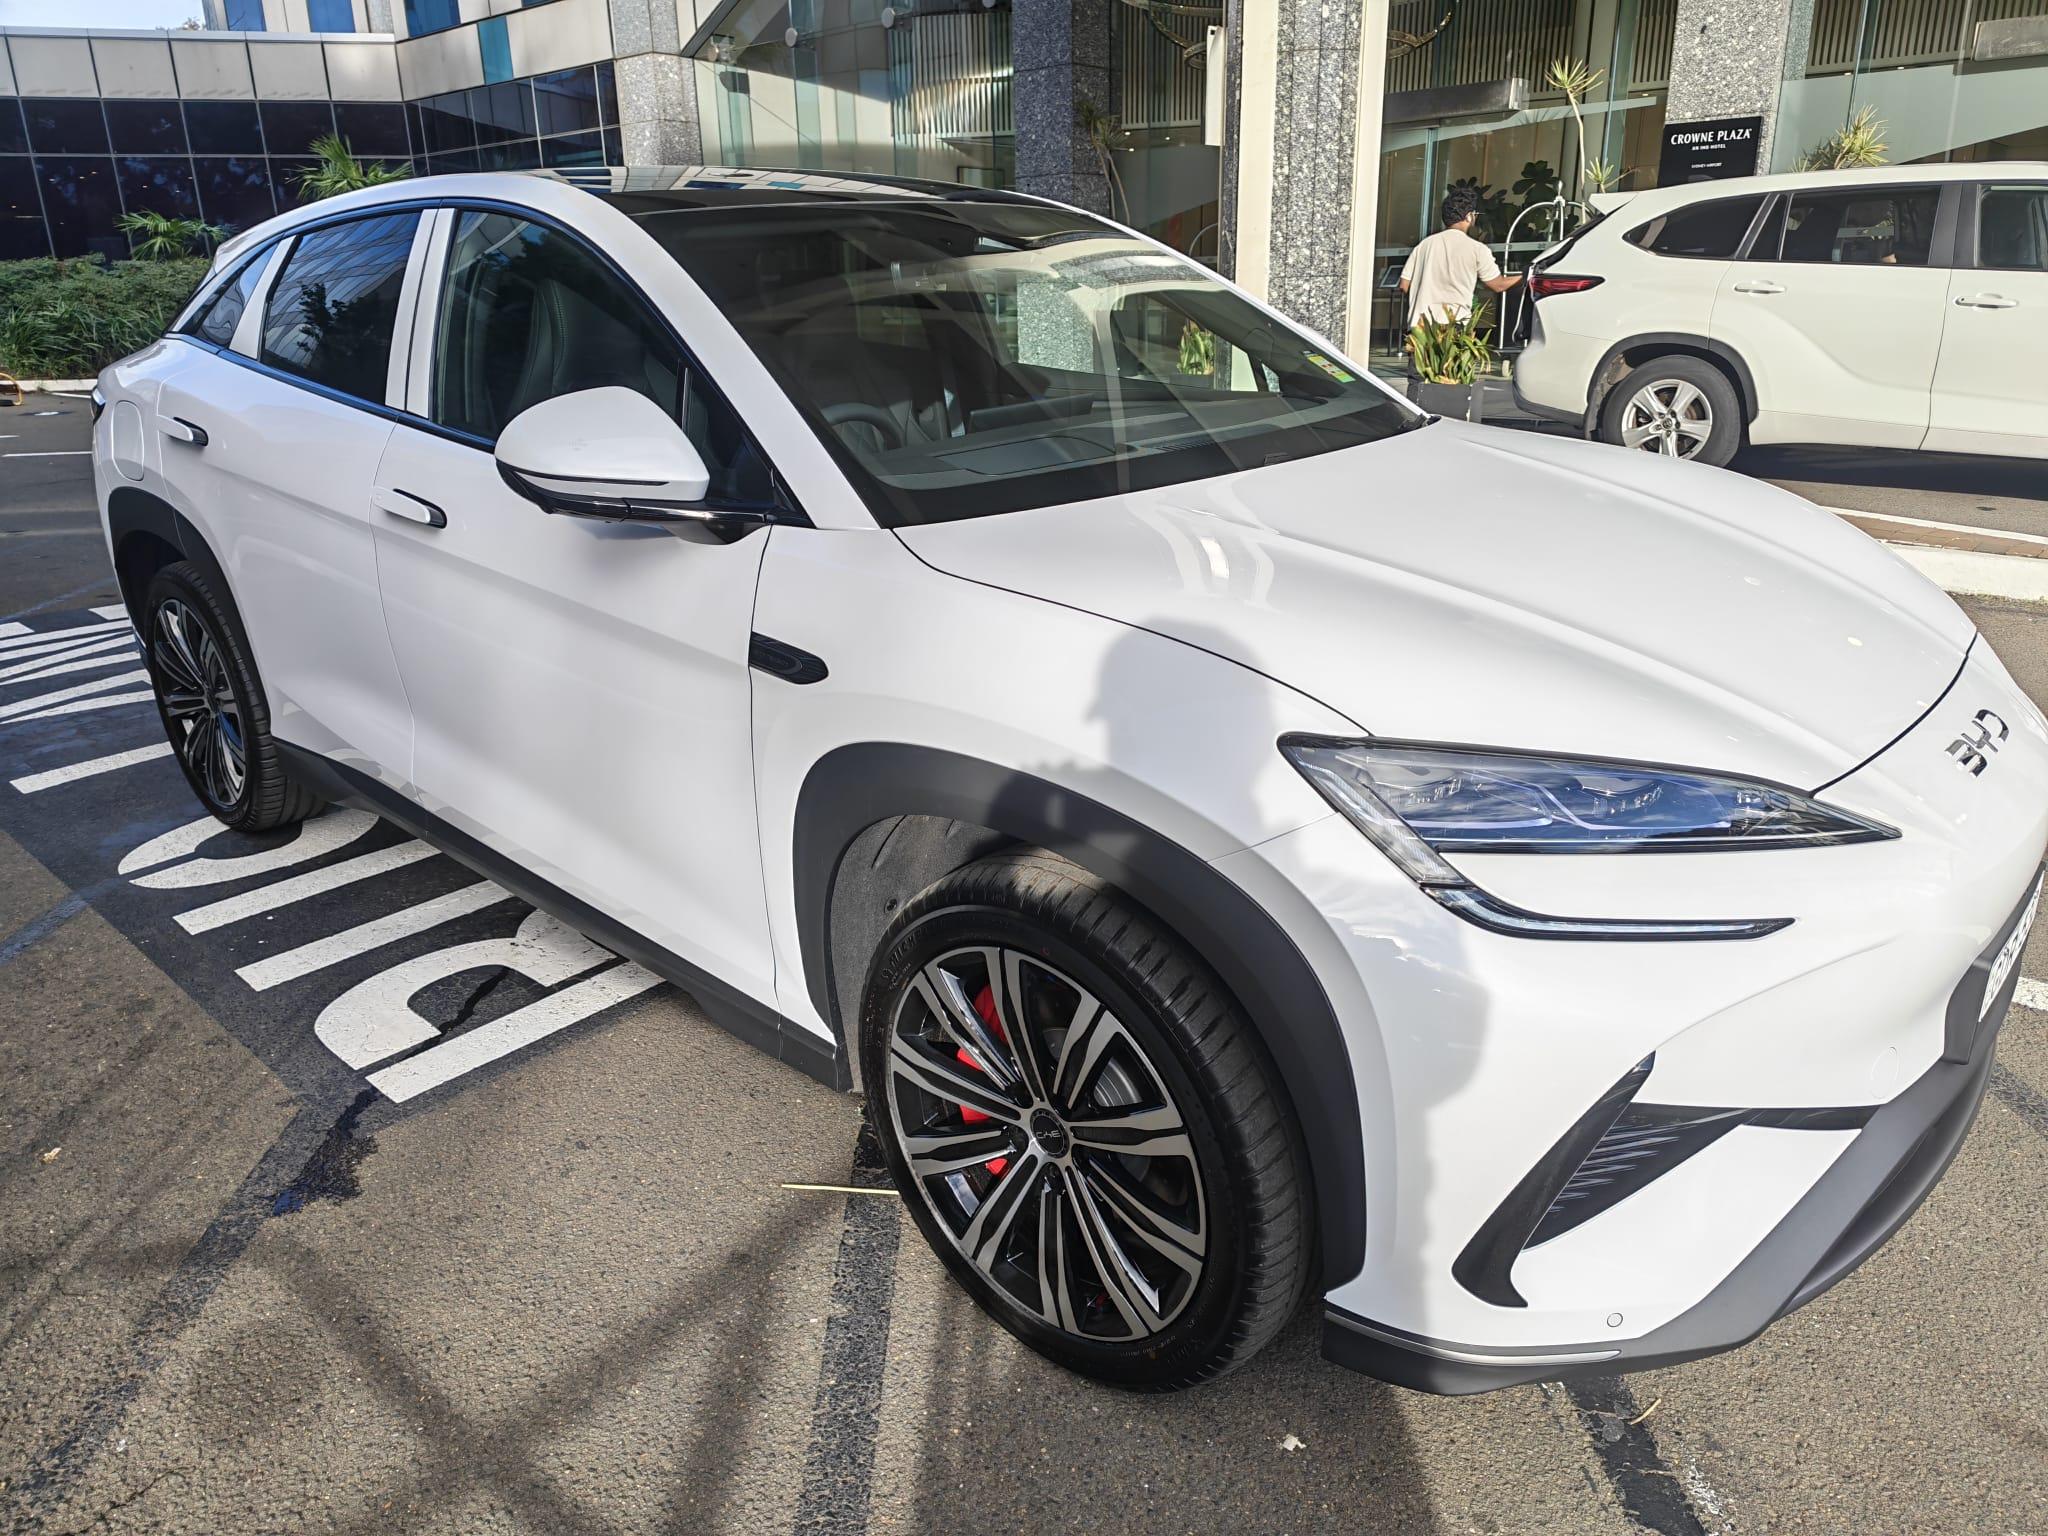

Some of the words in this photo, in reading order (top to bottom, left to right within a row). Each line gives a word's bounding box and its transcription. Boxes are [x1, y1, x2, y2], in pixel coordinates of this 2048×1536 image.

[1670, 131, 1714, 145] CROWNE
[1717, 128, 1752, 141] PLAZA
[1944, 709, 2009, 777] BYD
